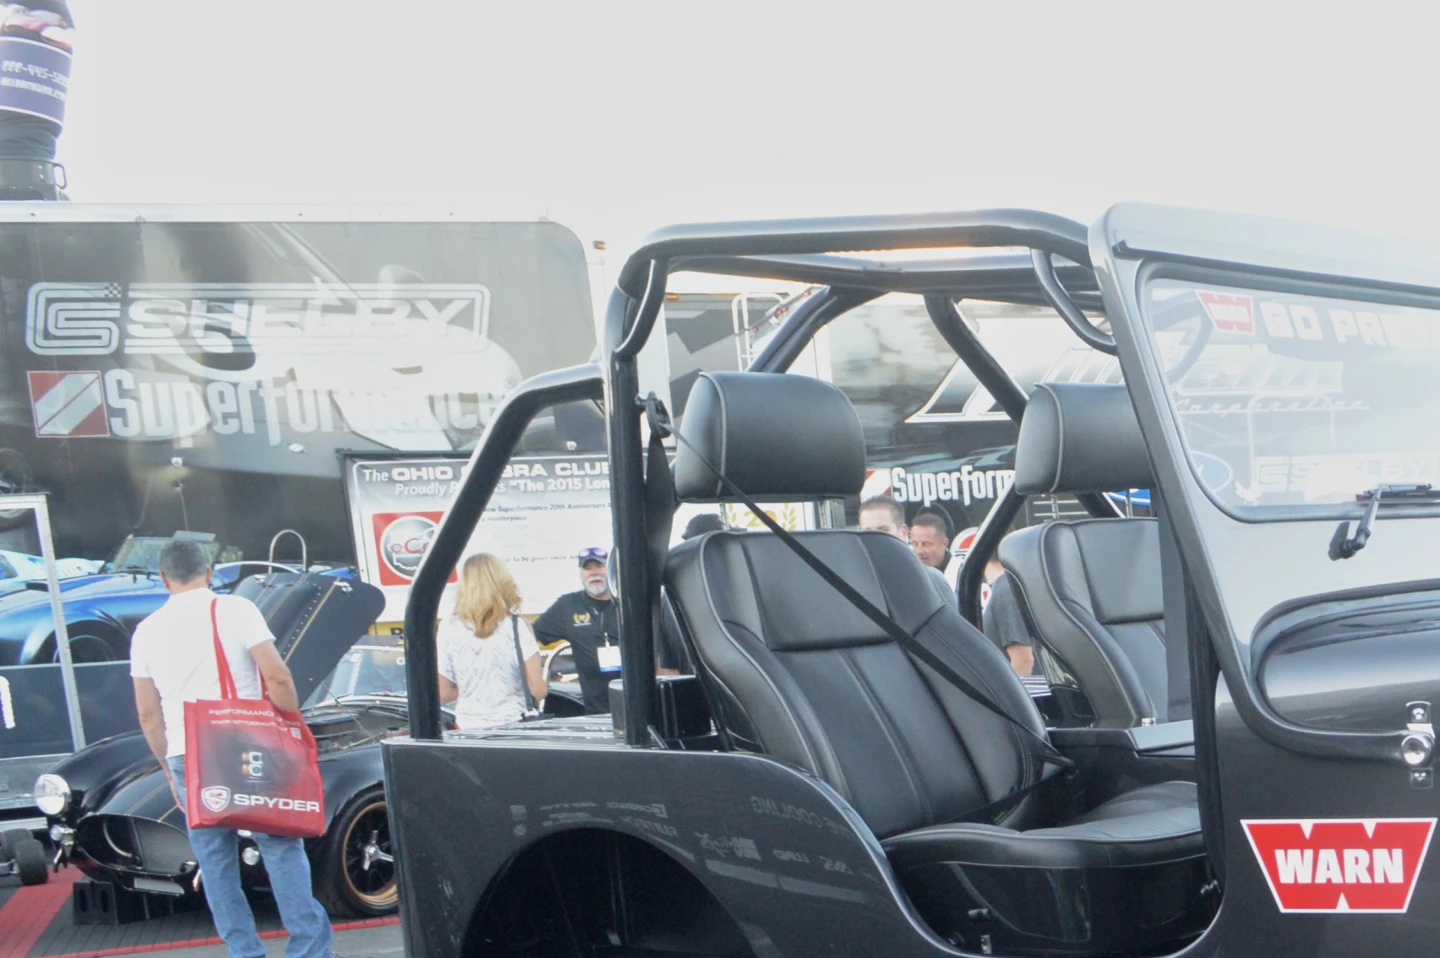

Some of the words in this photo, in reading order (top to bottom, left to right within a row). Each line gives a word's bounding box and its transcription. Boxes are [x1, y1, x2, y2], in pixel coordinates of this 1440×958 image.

[127, 299, 472, 338] SHELBY
[104, 368, 502, 448] Superforc
[363, 469, 389, 482] The
[391, 466, 454, 481] OHIO
[395, 483, 447, 496] Proudly
[549, 477, 583, 490] 2015
[550, 503, 566, 511] 20th
[567, 502, 606, 511] Anniversary
[487, 514, 527, 523] masterpiece
[233, 793, 321, 813] SPYDER
[1274, 848, 1404, 884] WARN
